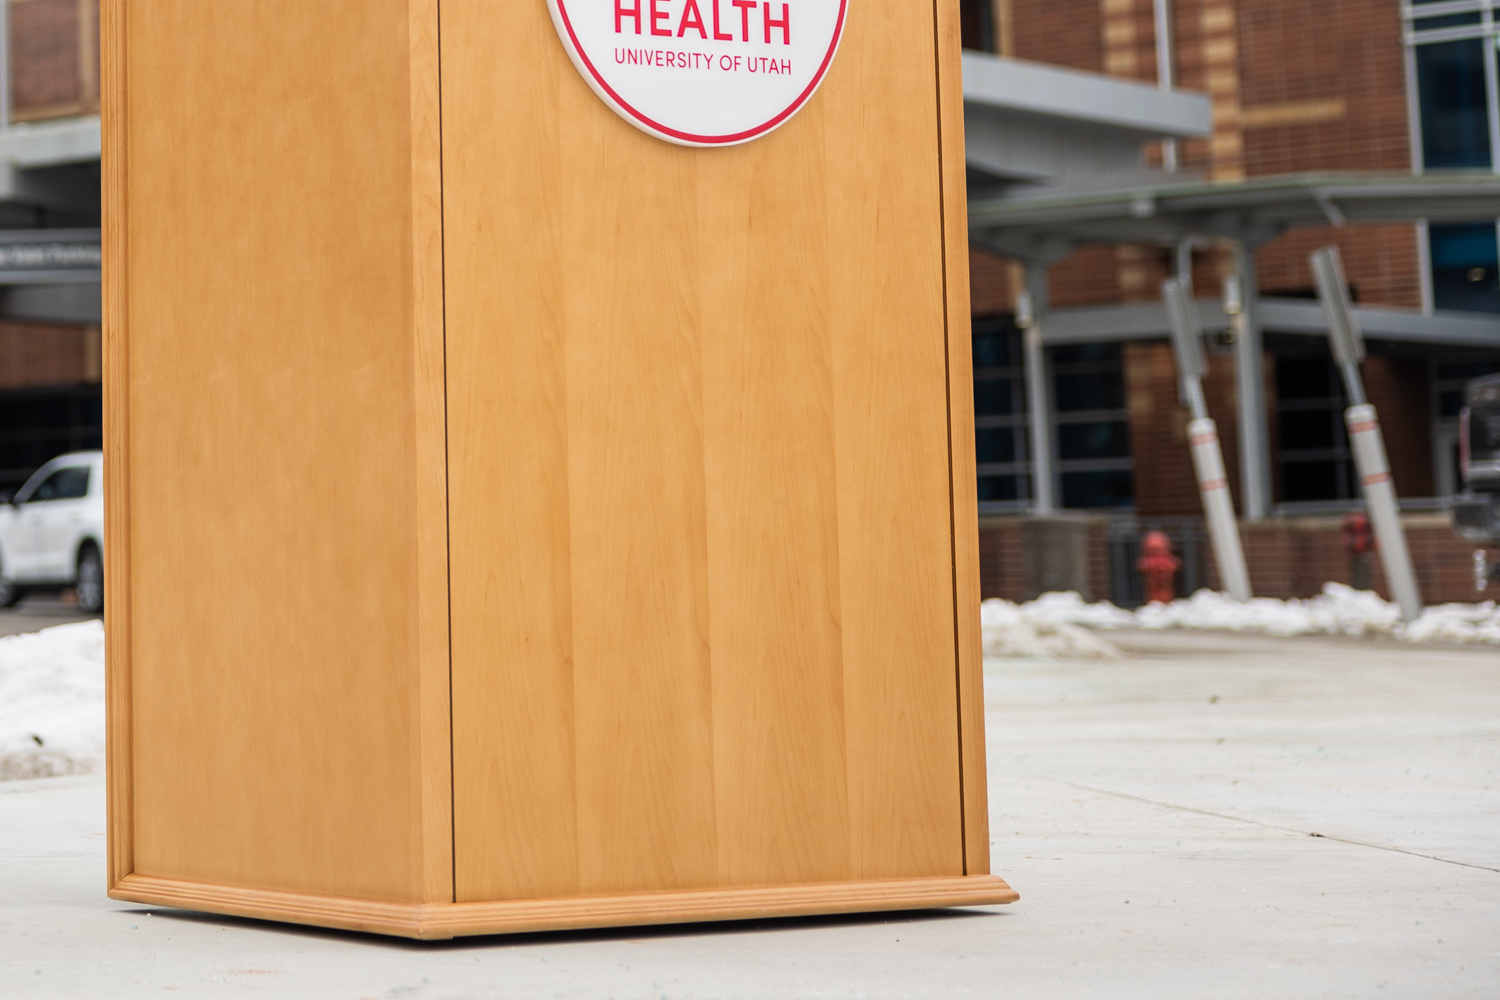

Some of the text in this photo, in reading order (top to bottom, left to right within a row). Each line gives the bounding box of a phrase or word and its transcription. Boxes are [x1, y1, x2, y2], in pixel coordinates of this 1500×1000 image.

[614, 47, 792, 75] UNIVERSITY OF UTAH
